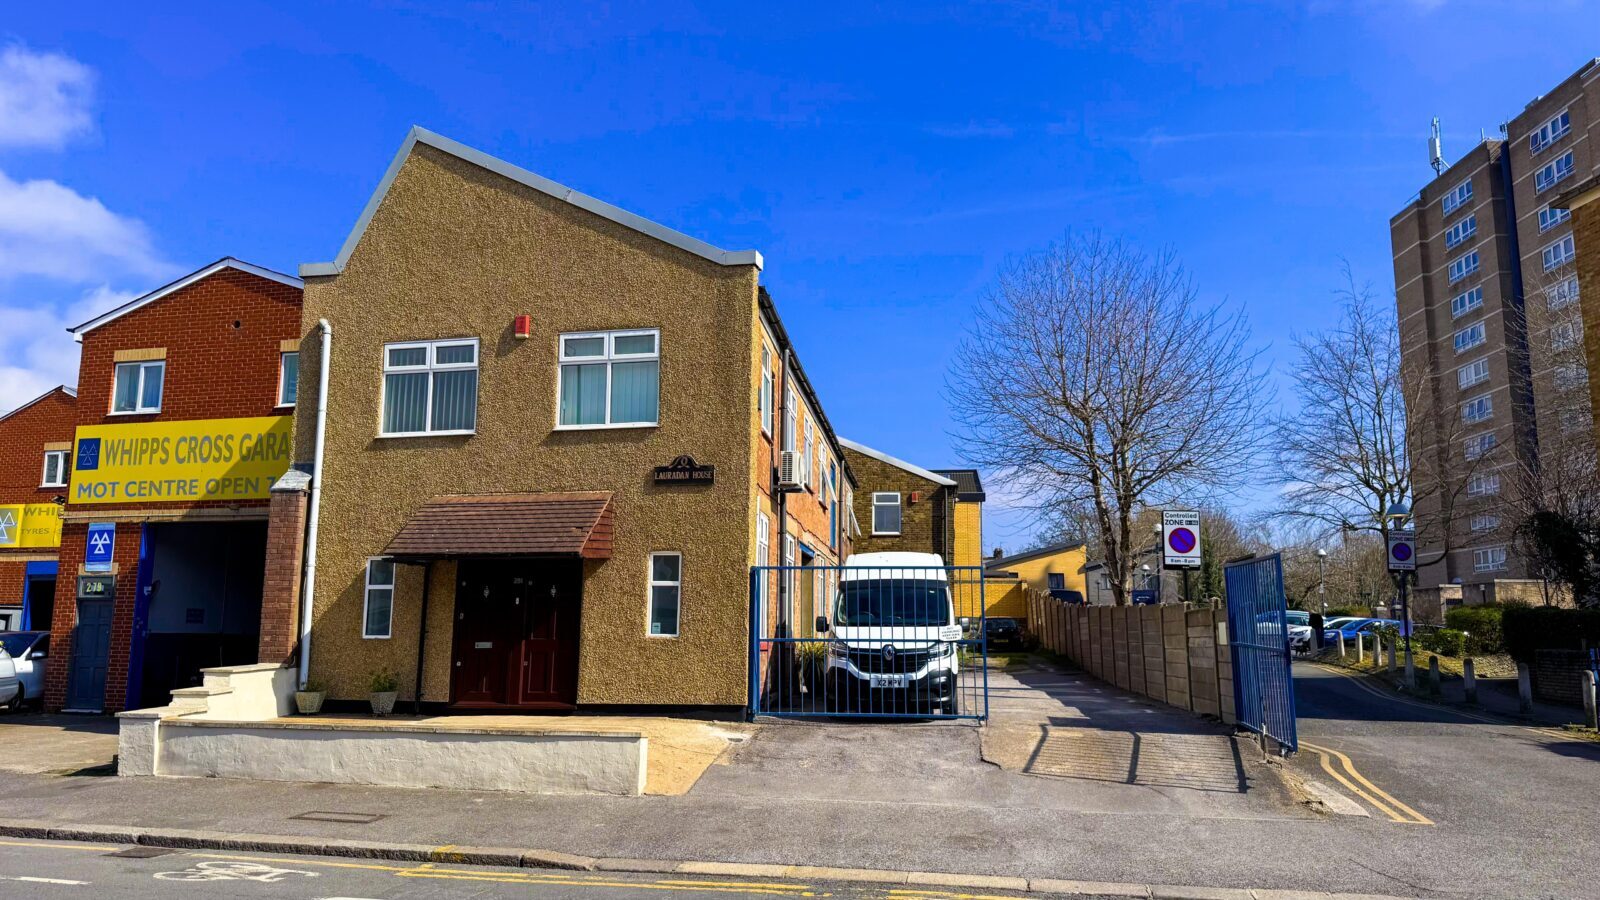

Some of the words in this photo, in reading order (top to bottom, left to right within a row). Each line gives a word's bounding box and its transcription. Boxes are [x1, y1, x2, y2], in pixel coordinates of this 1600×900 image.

[105, 437, 171, 467] WHIPPS
[174, 434, 234, 465] CROSS
[239, 432, 290, 462] GARA
[654, 471, 690, 480] LAURADAN
[692, 470, 713, 479] HOUSE
[76, 481, 121, 499] MOT
[124, 478, 200, 498] CENTRE
[205, 477, 260, 495] OPEN
[21, 527, 50, 535] TYRES
[86, 582, 102, 592] 279
